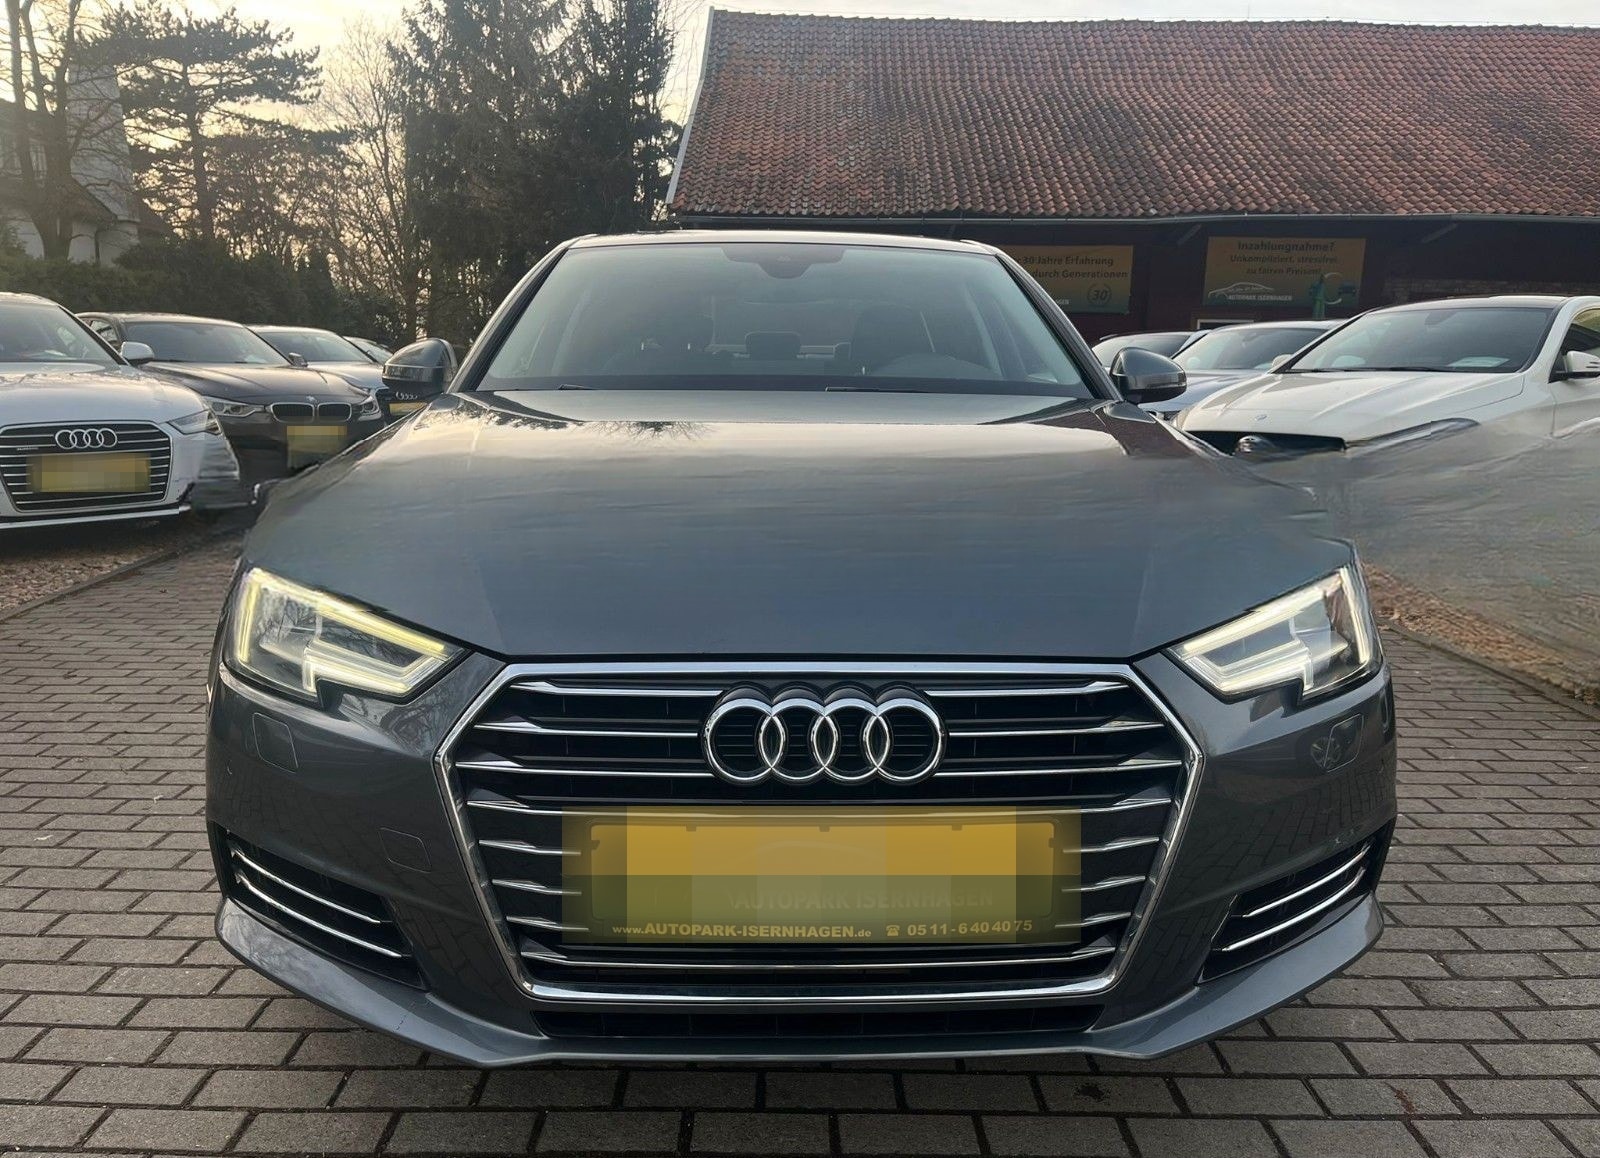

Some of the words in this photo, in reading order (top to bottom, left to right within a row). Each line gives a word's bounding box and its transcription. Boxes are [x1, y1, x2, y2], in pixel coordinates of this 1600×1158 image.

[1237, 241, 1335, 253] Inzahlungnahme?
[1037, 257, 1063, 266] Jahre
[1065, 257, 1114, 268] Erfahrung
[1034, 270, 1059, 279] durch
[1062, 270, 1129, 279] Generationen
[1093, 289, 1109, 301] 30
[734, 888, 849, 910] AUTOPARK
[855, 887, 994, 909] ISERNHAGEN
[612, 922, 872, 938] www.AUTOPARK-ISERNHAGEN.de
